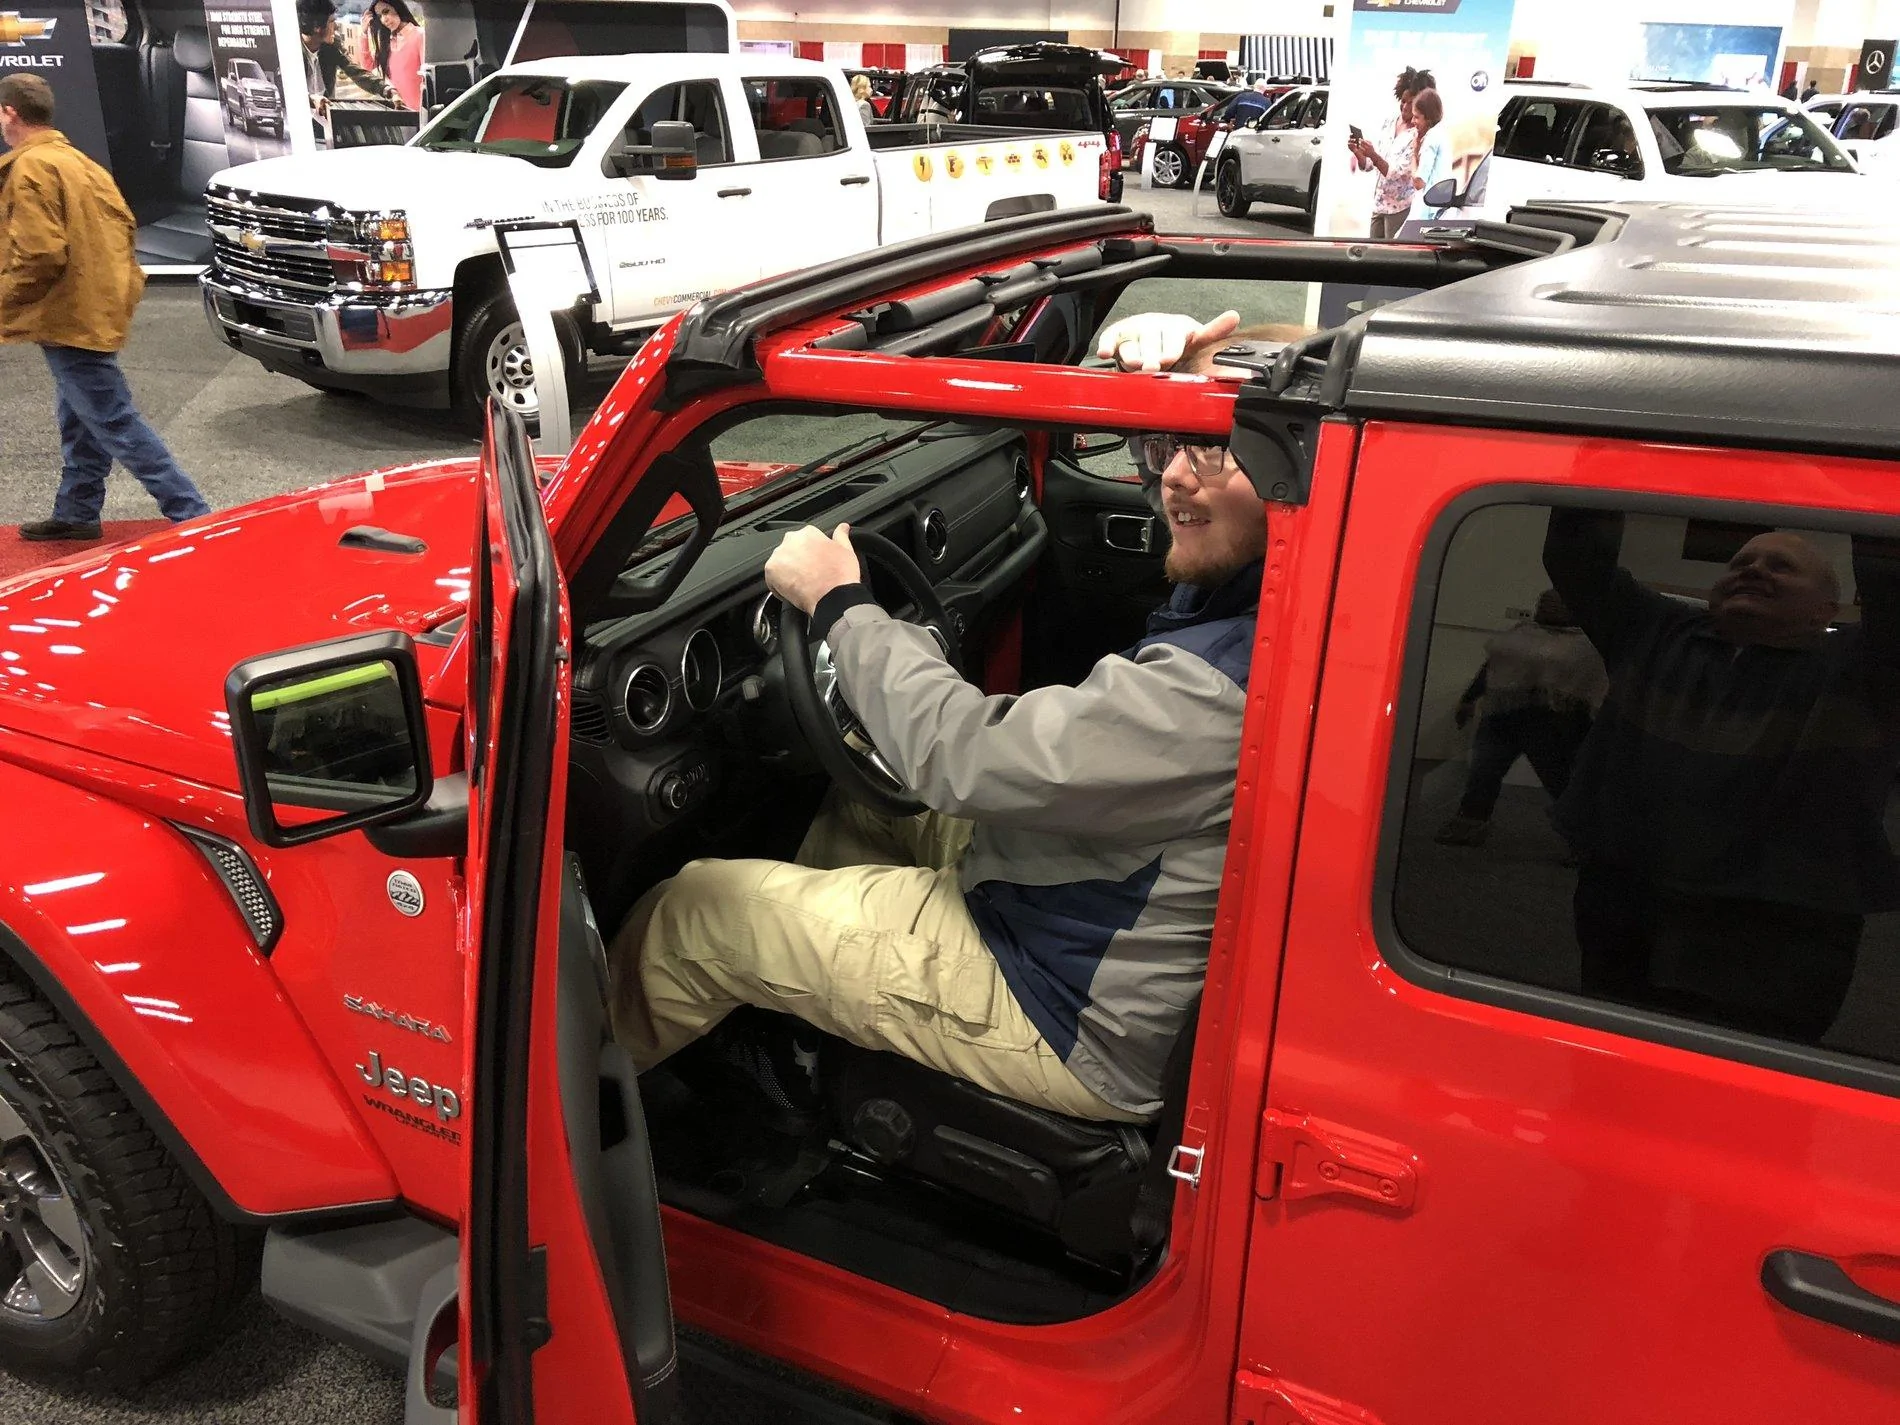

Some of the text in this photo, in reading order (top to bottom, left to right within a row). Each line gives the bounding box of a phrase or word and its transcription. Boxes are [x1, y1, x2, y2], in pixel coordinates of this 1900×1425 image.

[554, 198, 576, 212] THE
[626, 192, 640, 206] OF
[597, 211, 616, 226] FOR
[617, 209, 635, 224] 100
[635, 206, 669, 222] YEARS.
[343, 993, 453, 1043] SAHARA
[355, 1050, 461, 1122] Jeep
